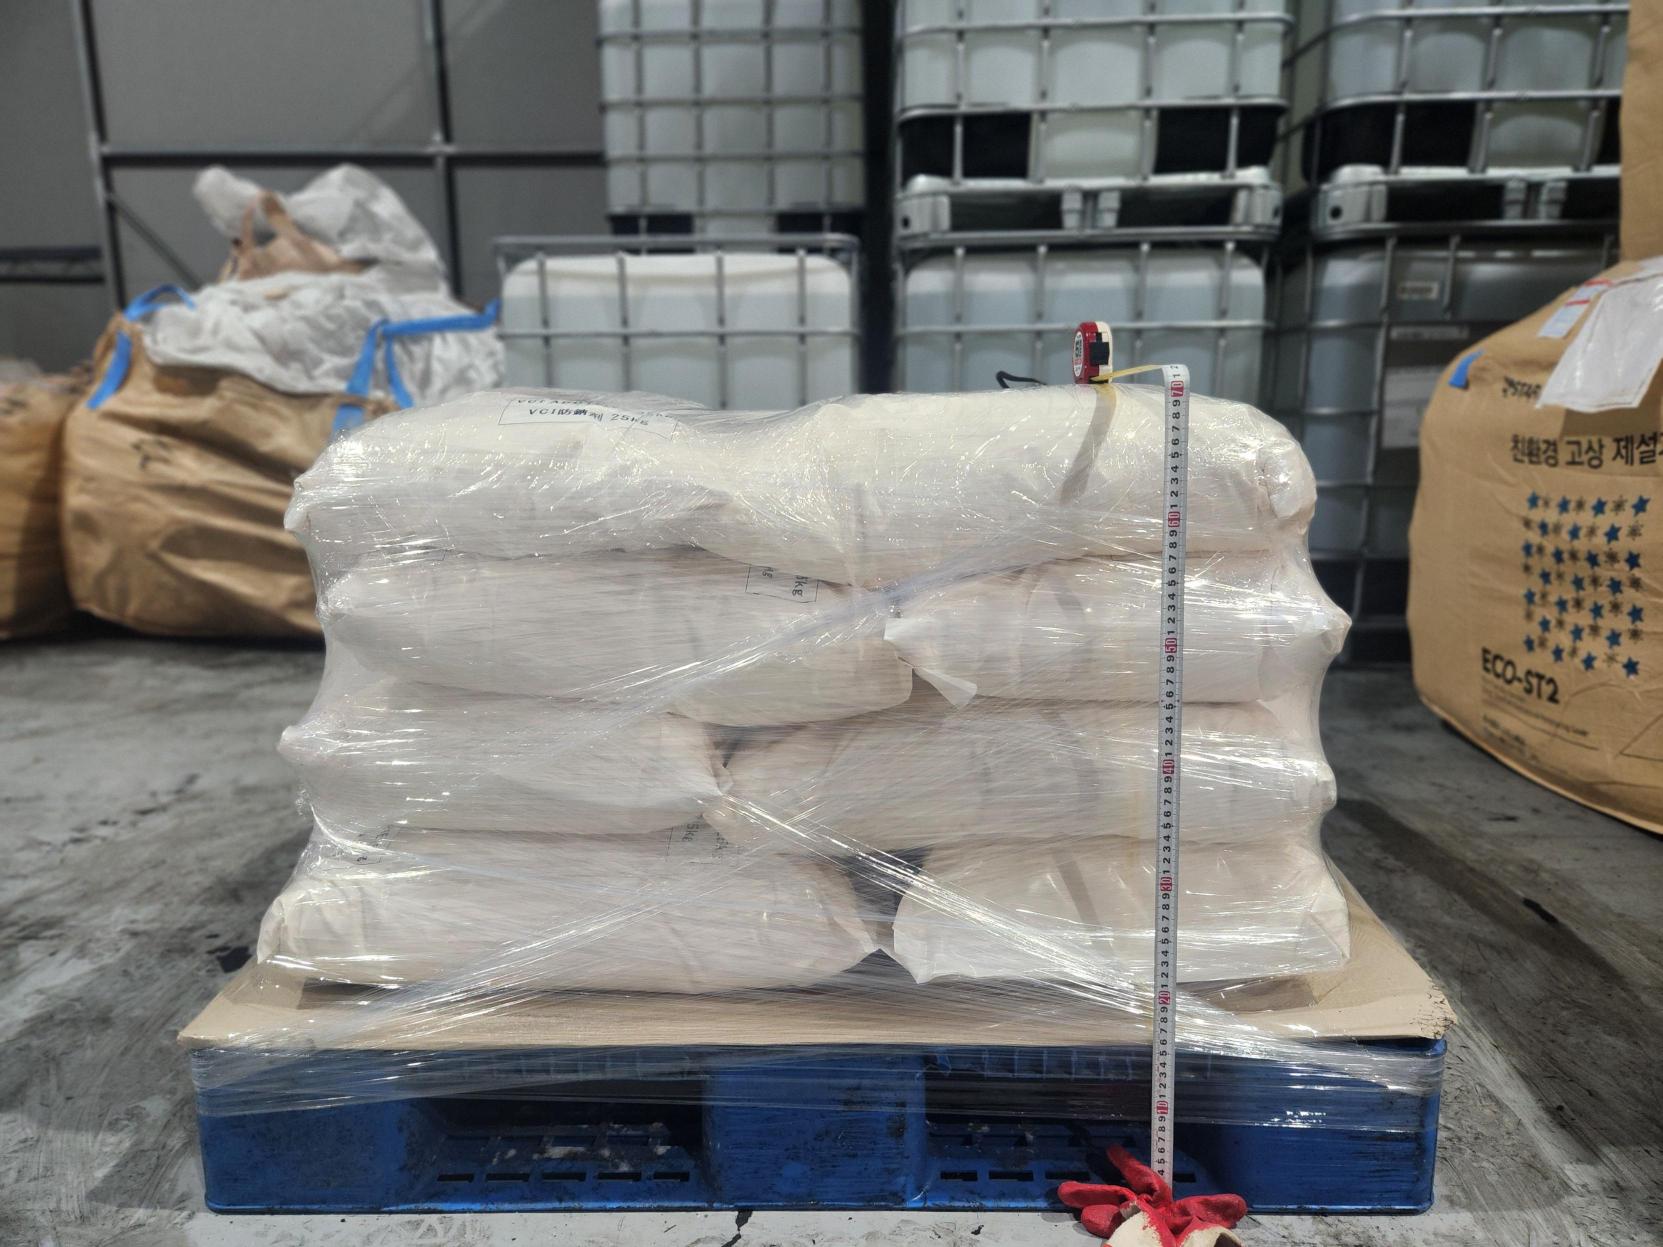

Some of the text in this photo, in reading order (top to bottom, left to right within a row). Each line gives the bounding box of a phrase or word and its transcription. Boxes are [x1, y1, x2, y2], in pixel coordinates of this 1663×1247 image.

[1172, 381, 1183, 396] 70
[1510, 433, 1559, 467] 친환경
[1565, 438, 1604, 469] 고상
[1169, 512, 1180, 527] 60
[1166, 640, 1177, 654] 50
[1481, 647, 1560, 704] ECO-ST2
[1164, 760, 1174, 774] 40
[1161, 877, 1172, 891] 30
[1159, 991, 1170, 1004] 20
[1157, 1101, 1168, 1115] 10
